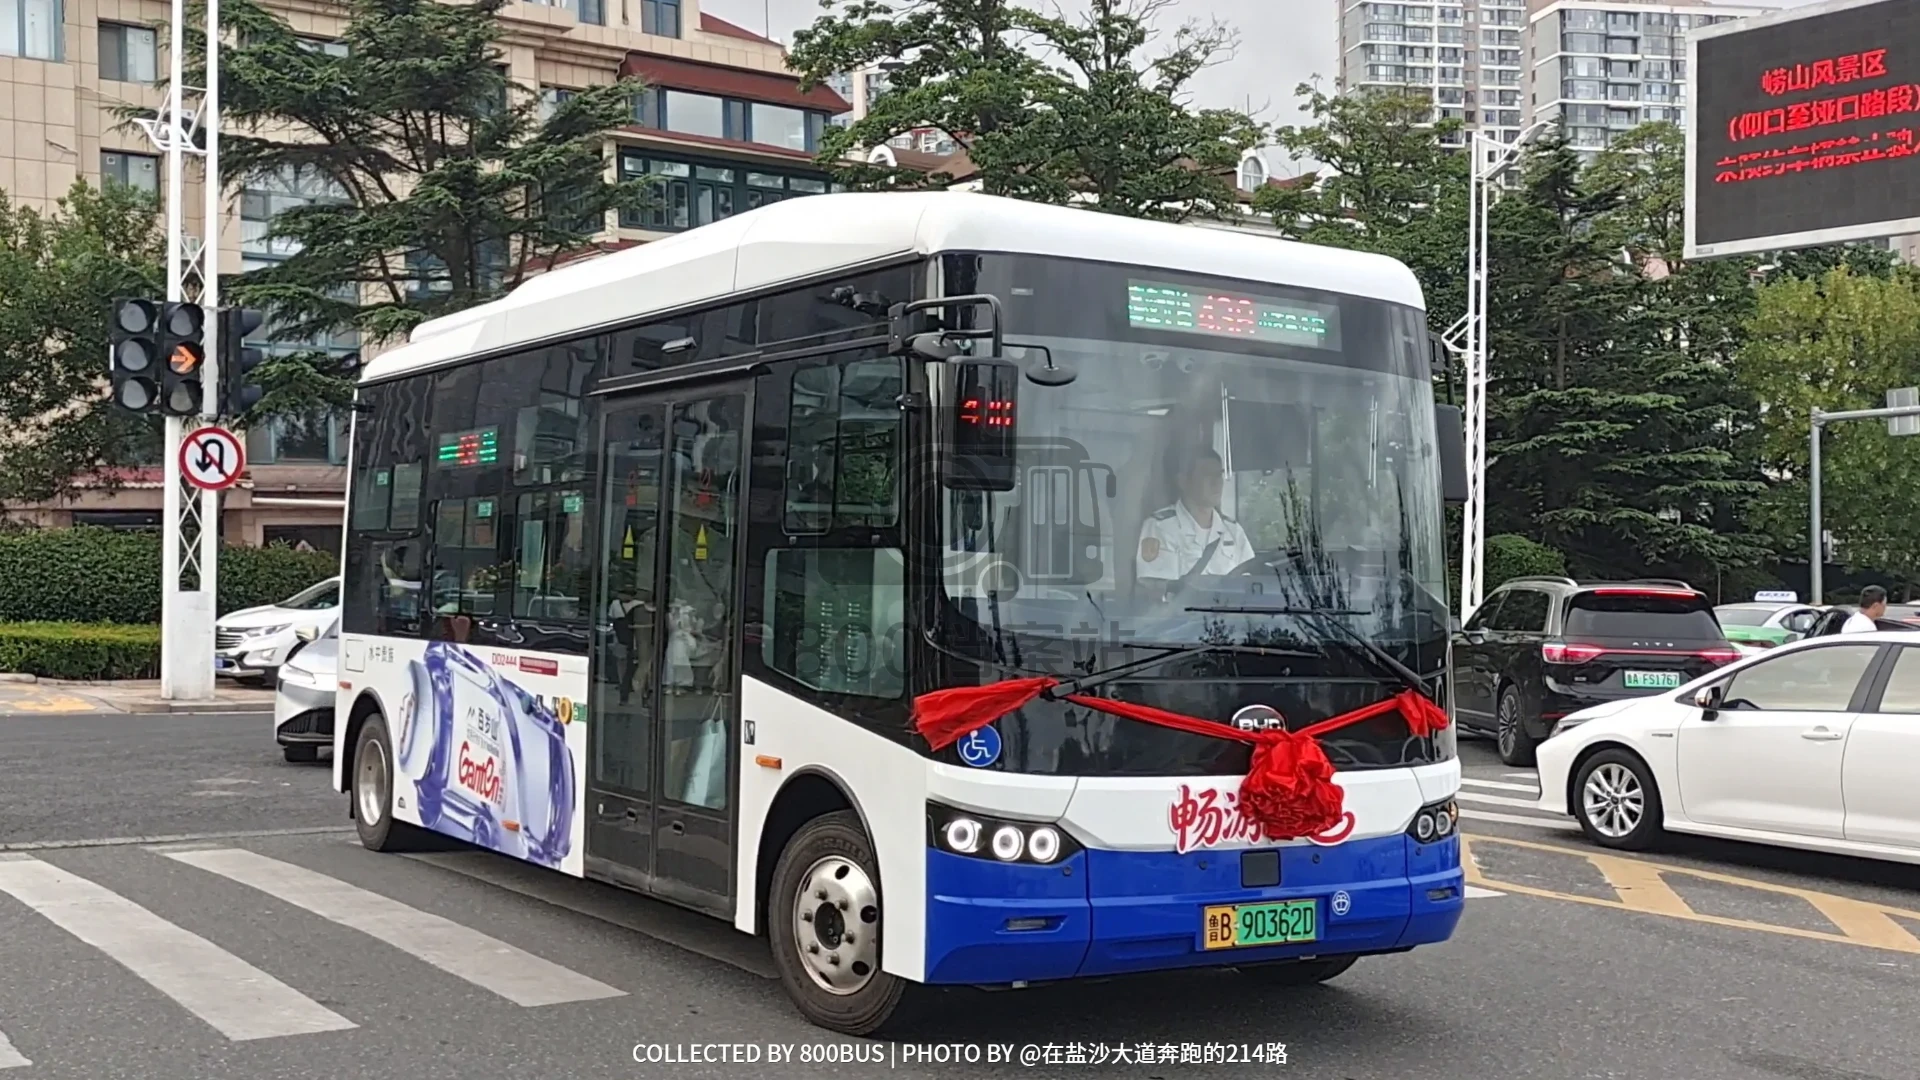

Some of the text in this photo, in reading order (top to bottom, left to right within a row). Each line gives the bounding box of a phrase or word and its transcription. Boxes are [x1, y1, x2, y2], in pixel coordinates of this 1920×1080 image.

[1762, 48, 1887, 95] 崂山风景区
